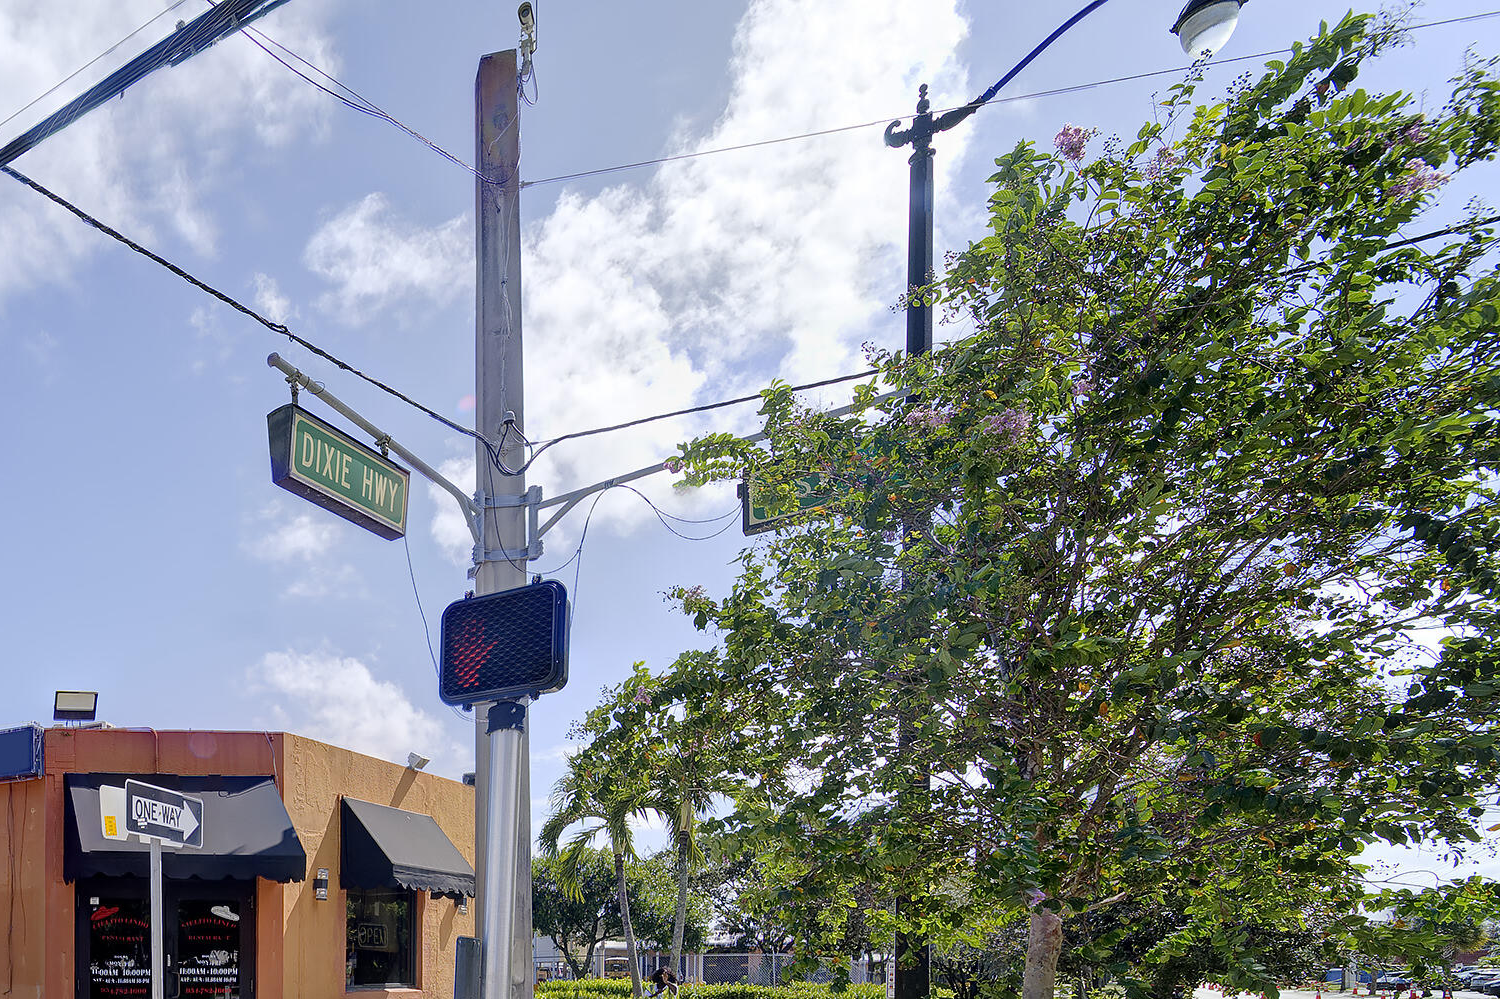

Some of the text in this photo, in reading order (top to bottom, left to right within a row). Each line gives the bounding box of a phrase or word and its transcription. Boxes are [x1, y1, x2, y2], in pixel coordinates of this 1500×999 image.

[302, 431, 398, 513] DIXIE HWY
[135, 799, 182, 828] ONE WAY
[359, 926, 387, 945] OPEN
